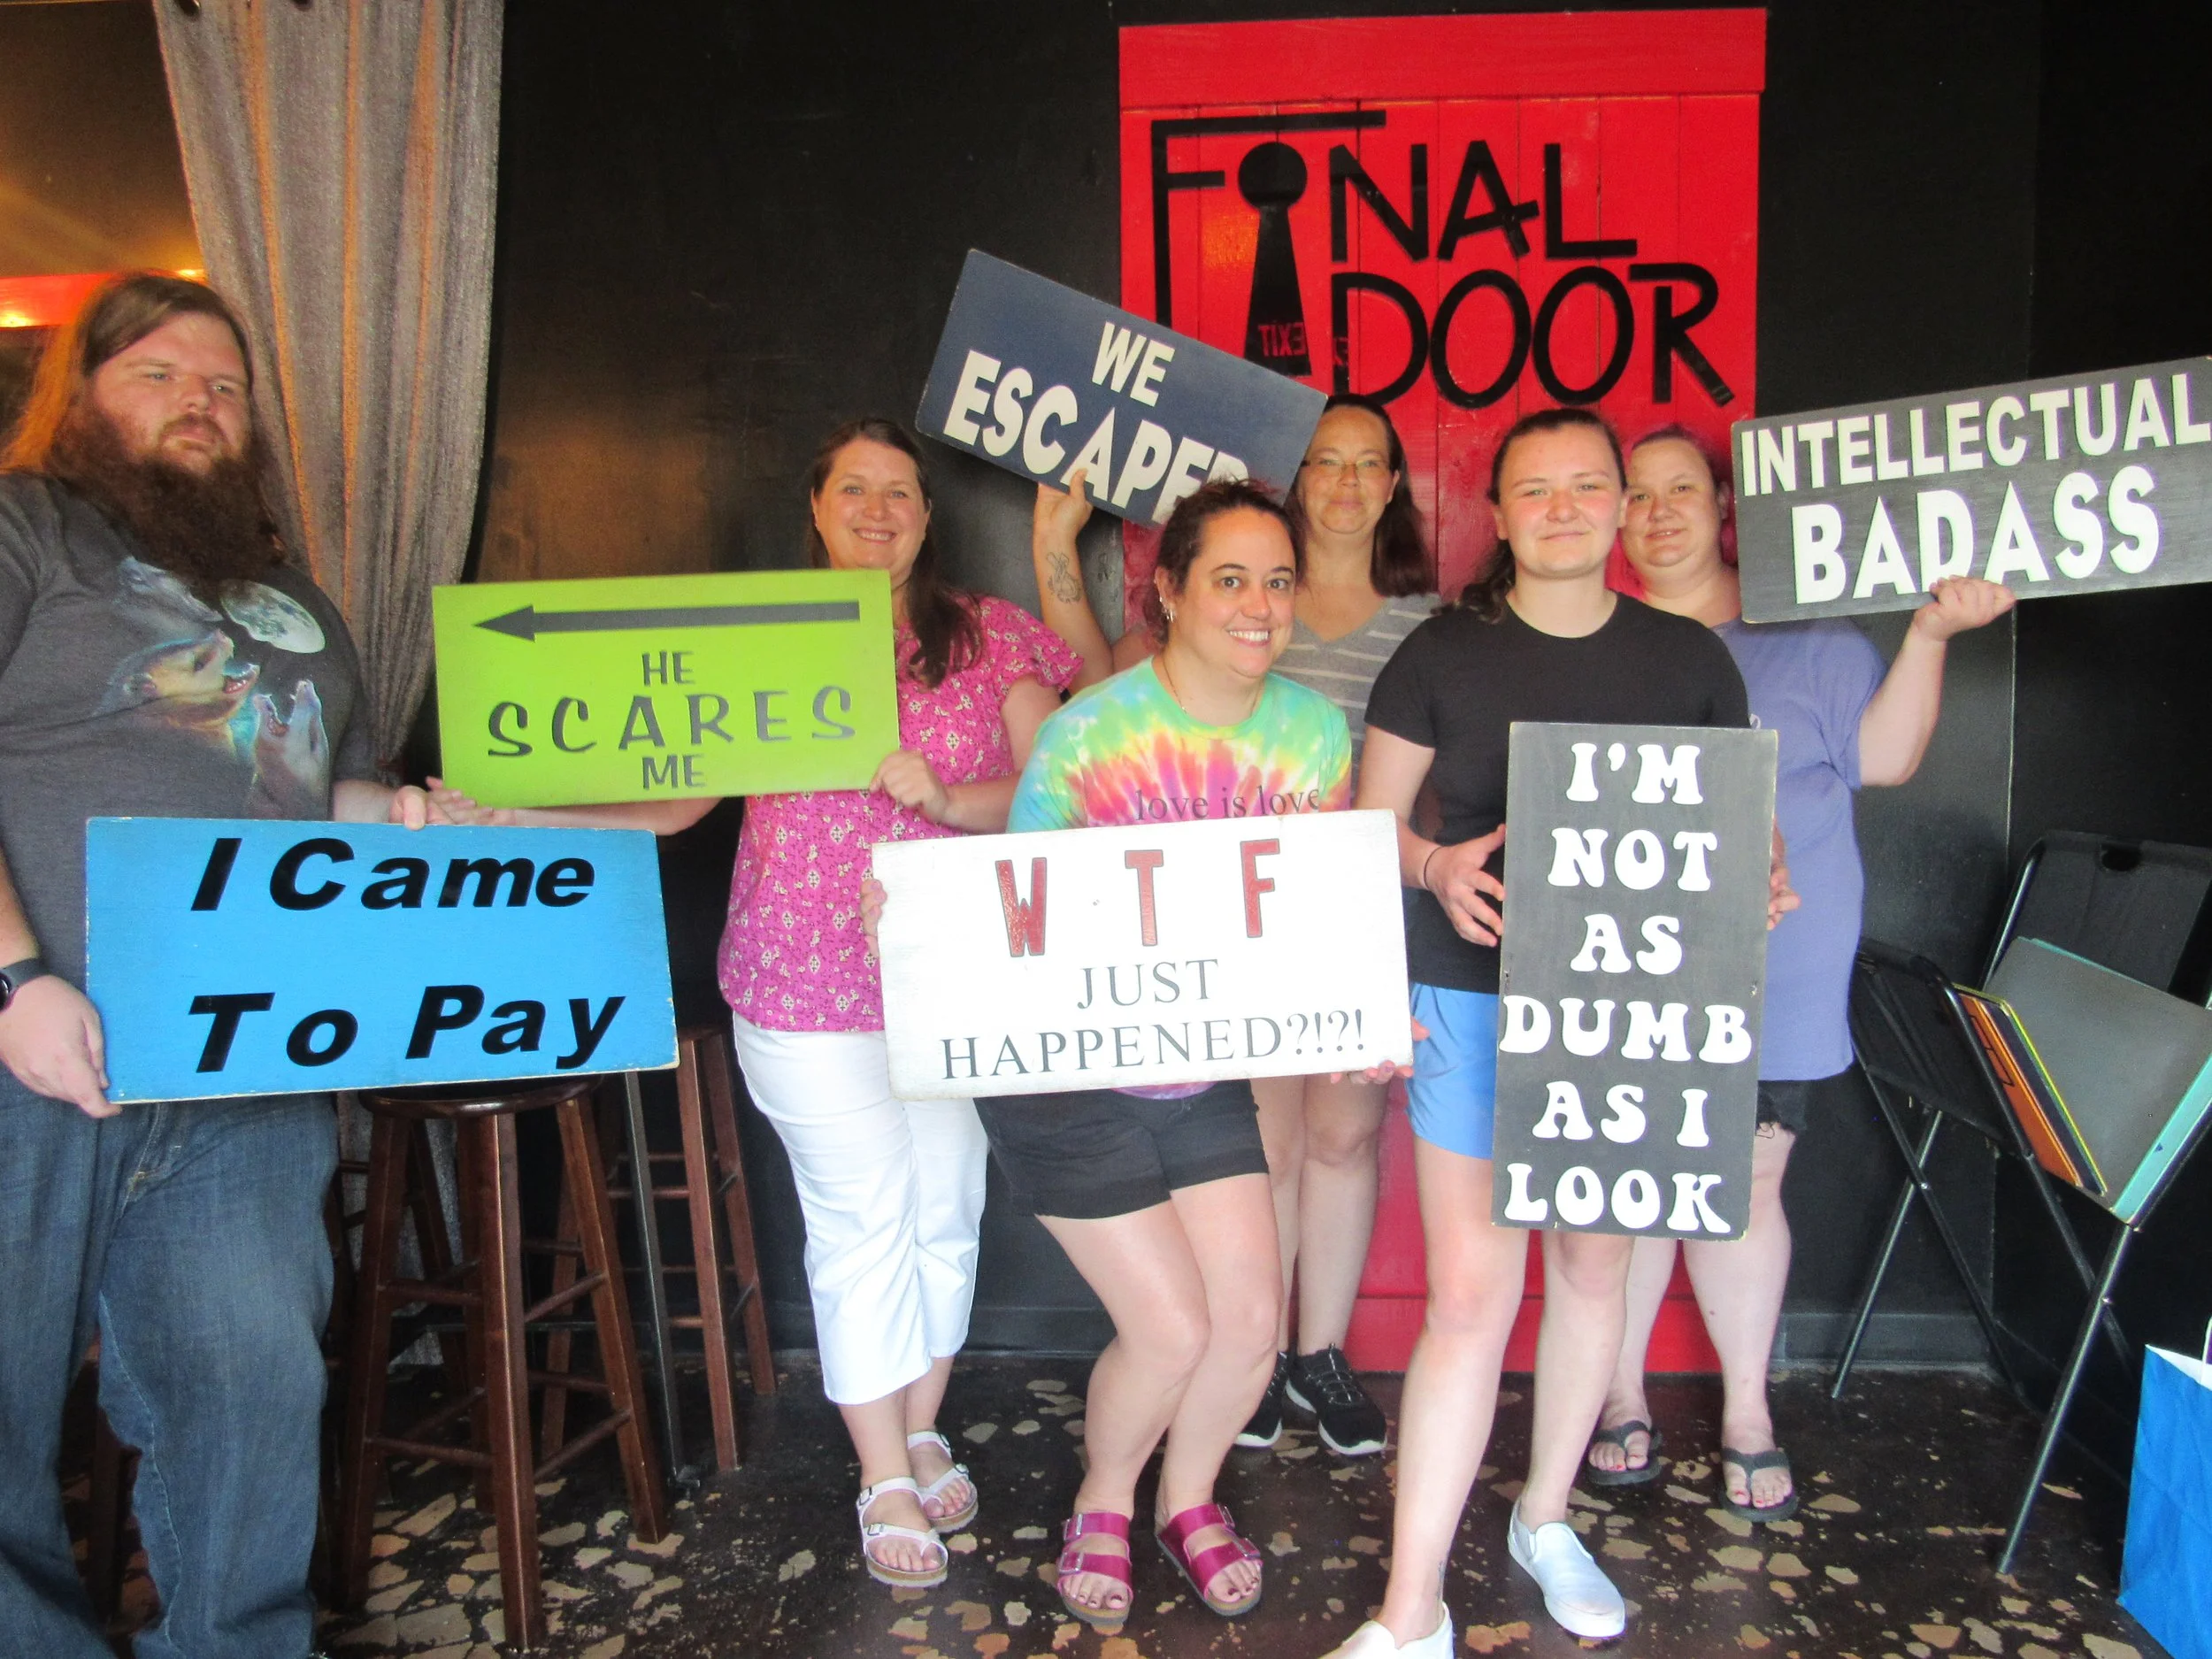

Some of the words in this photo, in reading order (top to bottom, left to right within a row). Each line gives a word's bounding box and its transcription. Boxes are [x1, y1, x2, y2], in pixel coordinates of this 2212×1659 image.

[1092, 321, 1175, 407] WE
[1331, 262, 1734, 409] DOOR
[1741, 373, 2211, 496] INTELLECTUAL
[1792, 465, 2160, 604] BADASS
[641, 649, 695, 687] HE
[488, 686, 856, 757] SCARES
[641, 754, 706, 789] ME
[1136, 789, 1209, 821] love
[1221, 787, 1248, 818] is
[1566, 742, 1703, 804] I'M
[190, 838, 242, 911] I
[269, 838, 595, 911] Came
[1547, 828, 1717, 891] NOT
[1570, 913, 1682, 975] AS
[1076, 958, 1218, 1010] JUST
[188, 992, 359, 1073] To
[404, 984, 626, 1070] Pay
[941, 1009, 1365, 1080] HAPPENED?!?!
[1499, 995, 1752, 1064] DUMB
[1532, 1080, 1647, 1143] AS
[1677, 1088, 1709, 1147] I
[1504, 1163, 1731, 1233] LOOK
